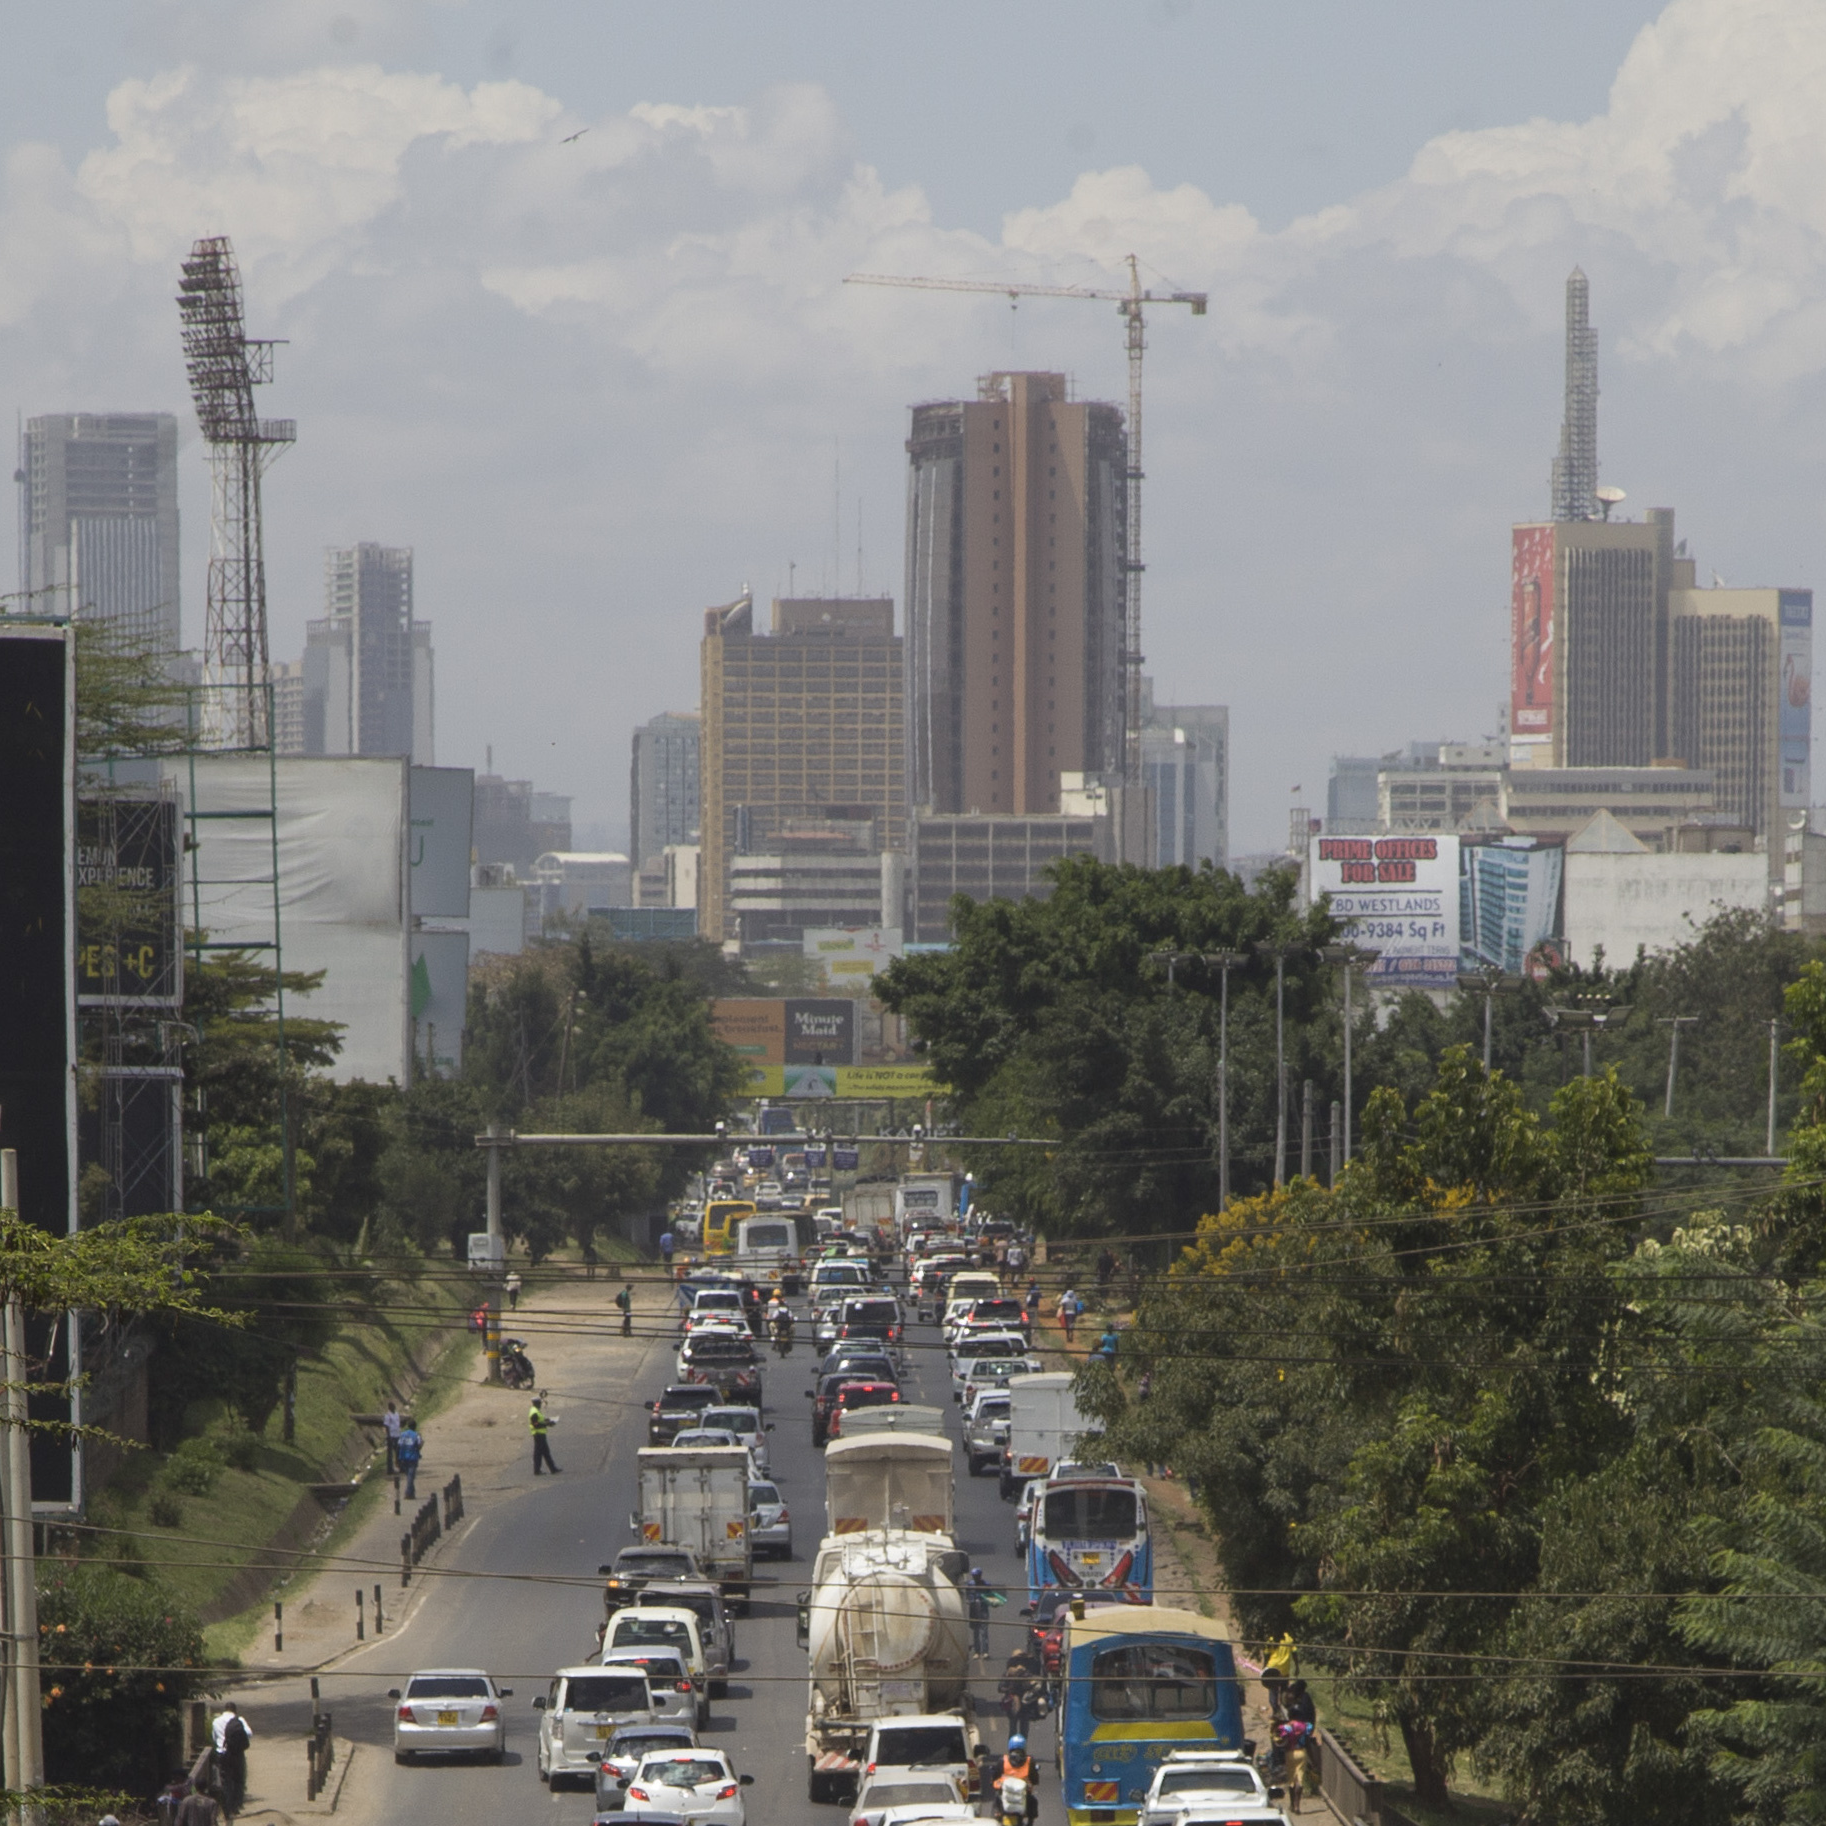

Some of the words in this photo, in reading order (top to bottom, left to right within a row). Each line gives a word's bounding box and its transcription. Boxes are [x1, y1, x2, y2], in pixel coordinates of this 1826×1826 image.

[1319, 838, 1373, 860] PRIME
[1374, 838, 1437, 860] OFFICES
[1341, 862, 1376, 883] FOR
[1377, 861, 1416, 882] SALE
[1359, 898, 1440, 912] WESTLANDS
[1409, 921, 1426, 941] Sq
[1432, 922, 1445, 938] Ft
[794, 1012, 844, 1025] Minute
[801, 1024, 837, 1036] Maid
